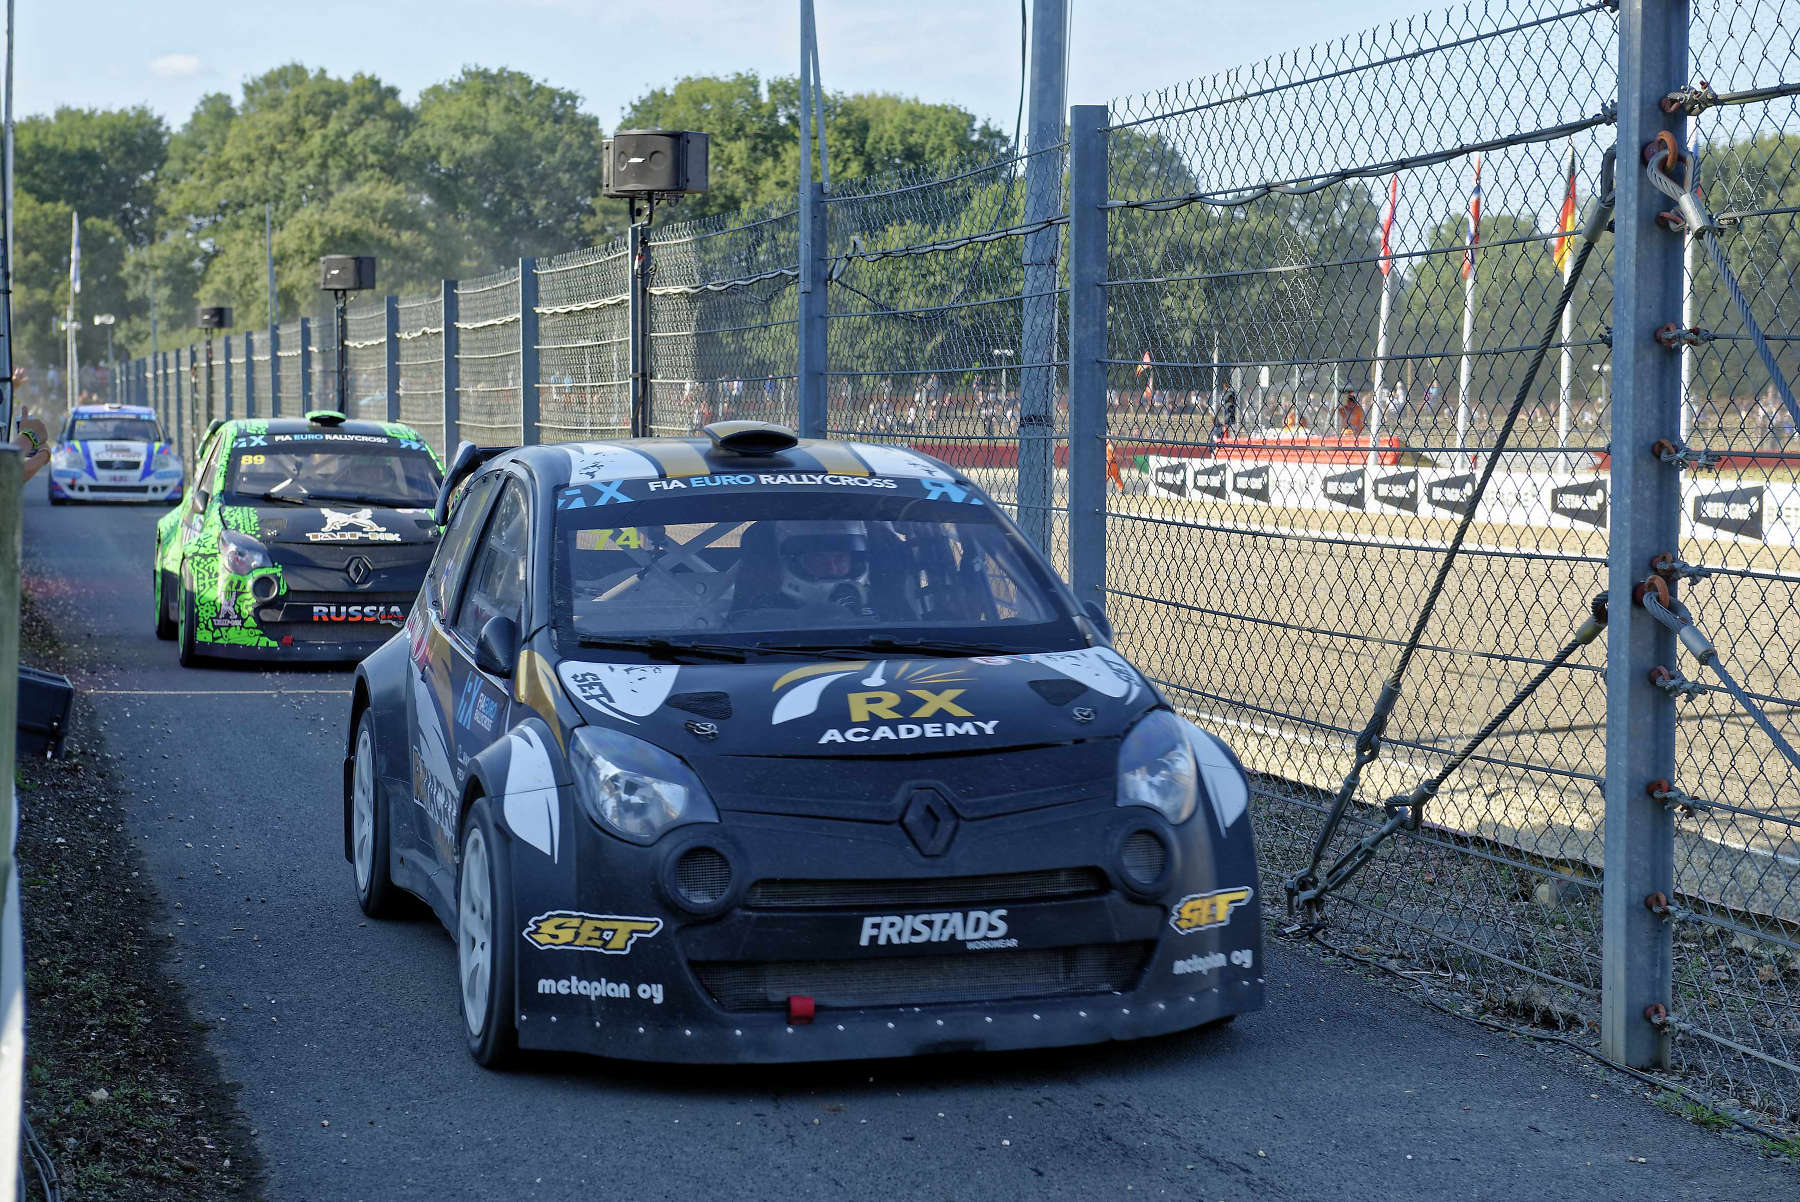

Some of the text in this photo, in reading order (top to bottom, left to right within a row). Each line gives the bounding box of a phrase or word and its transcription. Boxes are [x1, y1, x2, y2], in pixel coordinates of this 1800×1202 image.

[325, 434, 388, 444] RALLYCROSS
[240, 454, 266, 465] 89
[648, 474, 898, 492] FIA EURO RALLYCROSS
[588, 527, 641, 550] 74
[312, 605, 405, 622] RUSSIA
[847, 689, 977, 722] RX
[817, 720, 1000, 744] ACADEMY
[1175, 890, 1248, 929] SET
[529, 917, 658, 949] SET
[859, 909, 1008, 946] FRISTADS
[966, 938, 1019, 950] WORKWEAR
[537, 975, 664, 1004] metaplan oy
